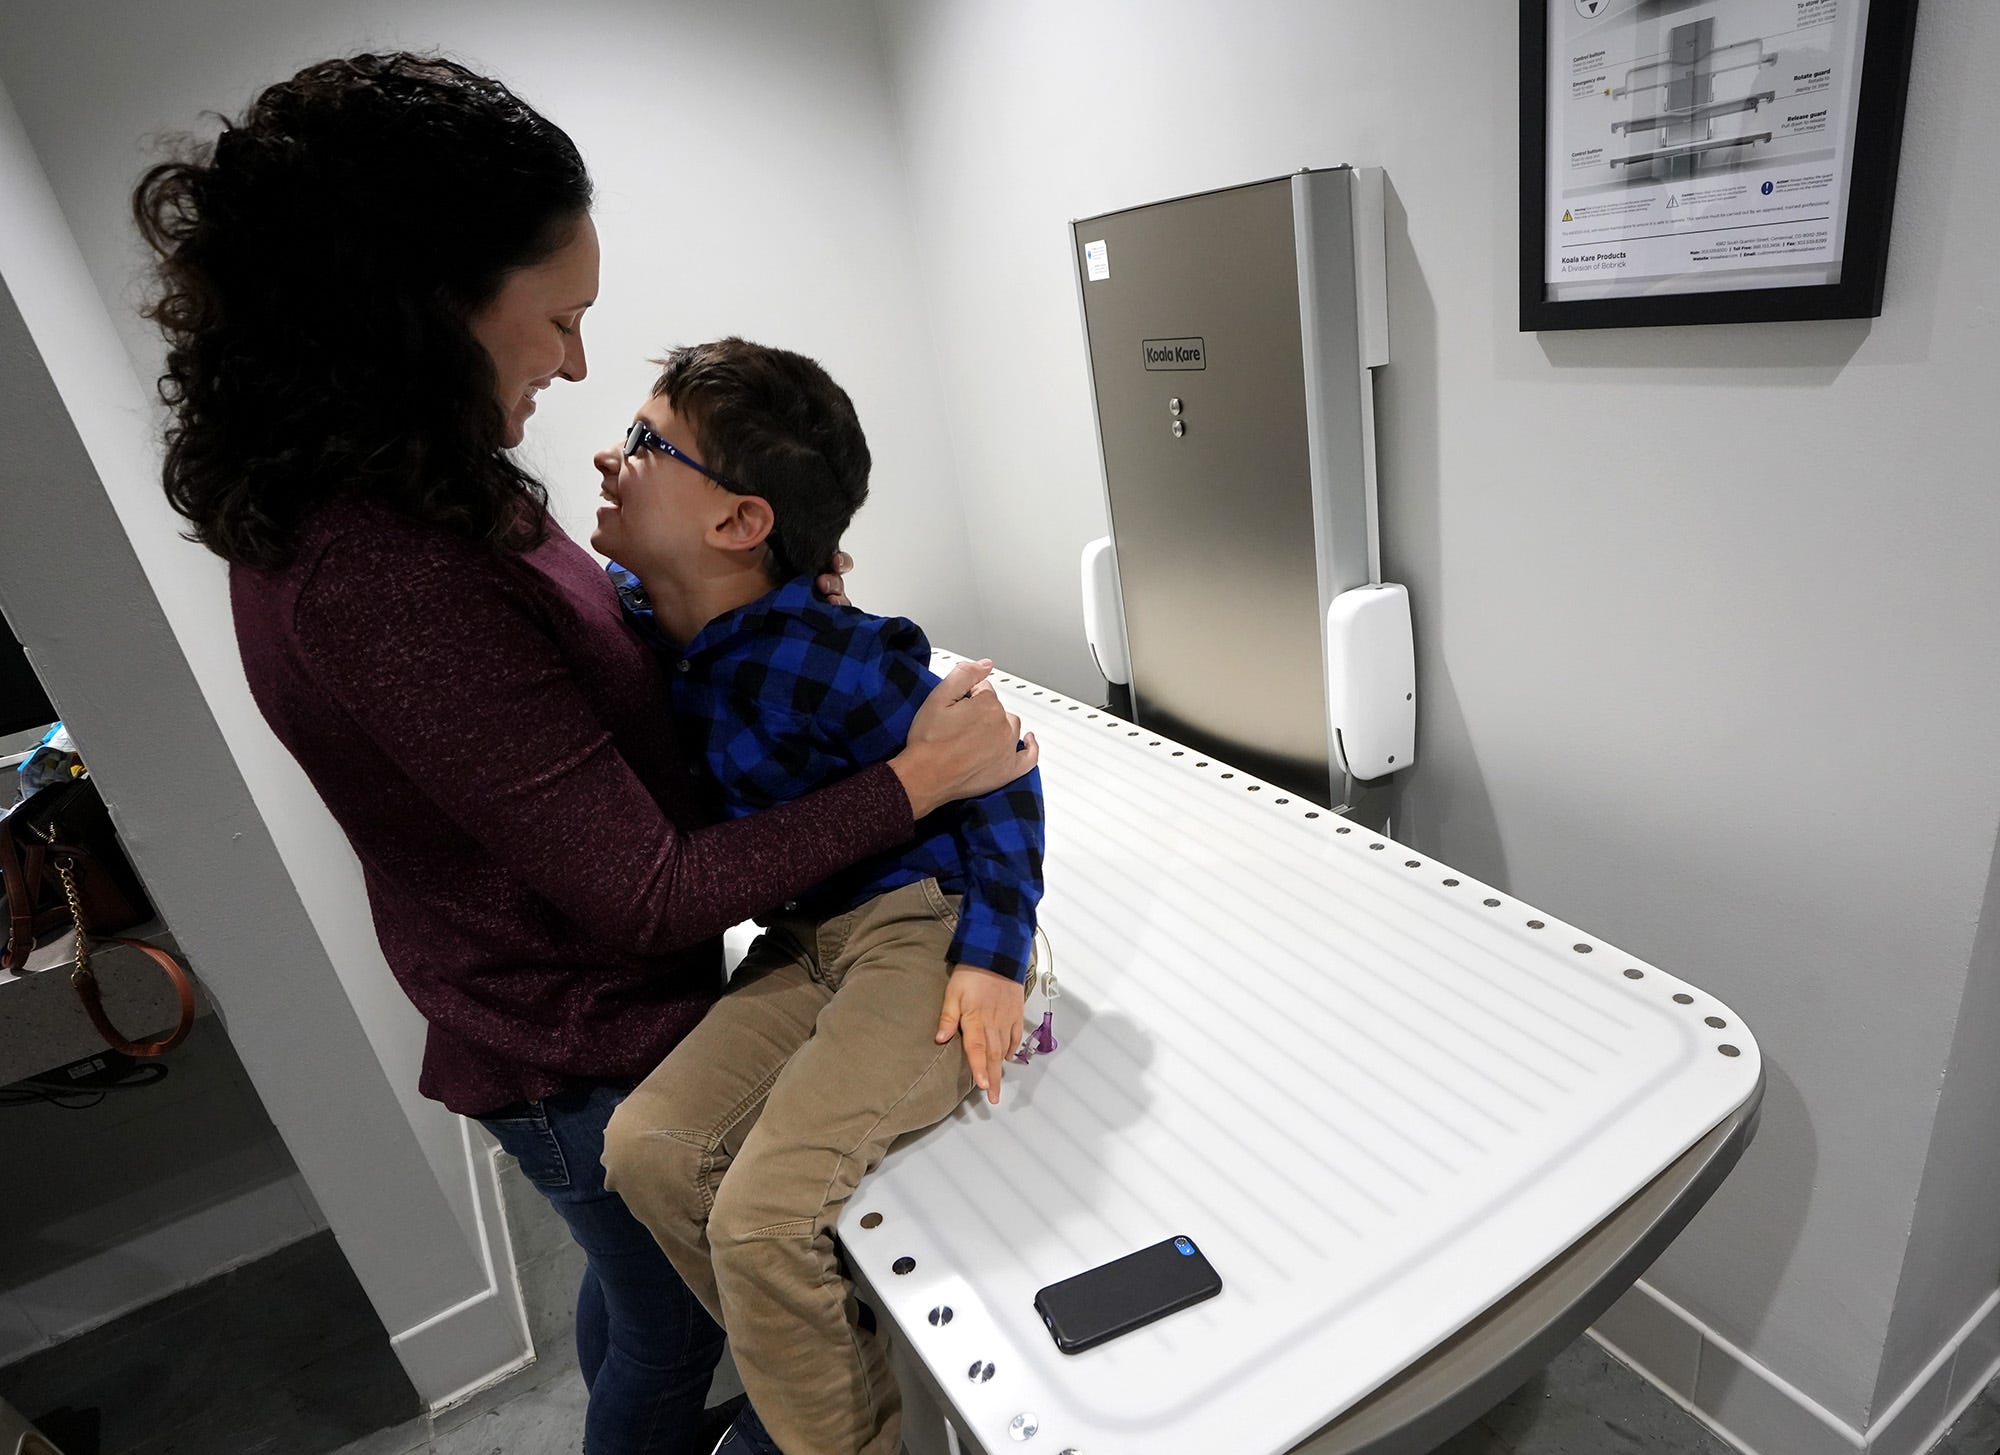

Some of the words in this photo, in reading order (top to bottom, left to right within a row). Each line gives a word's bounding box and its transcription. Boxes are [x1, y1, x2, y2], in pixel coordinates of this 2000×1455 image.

[1561, 255, 1580, 264] Koala
[1580, 255, 1596, 263] Kare
[1596, 251, 1627, 261] Products
[1567, 263, 1593, 273] Division
[1601, 260, 1627, 270] Bobrick
[1146, 345, 1174, 363] Koala
[1174, 346, 1201, 363] Kare
